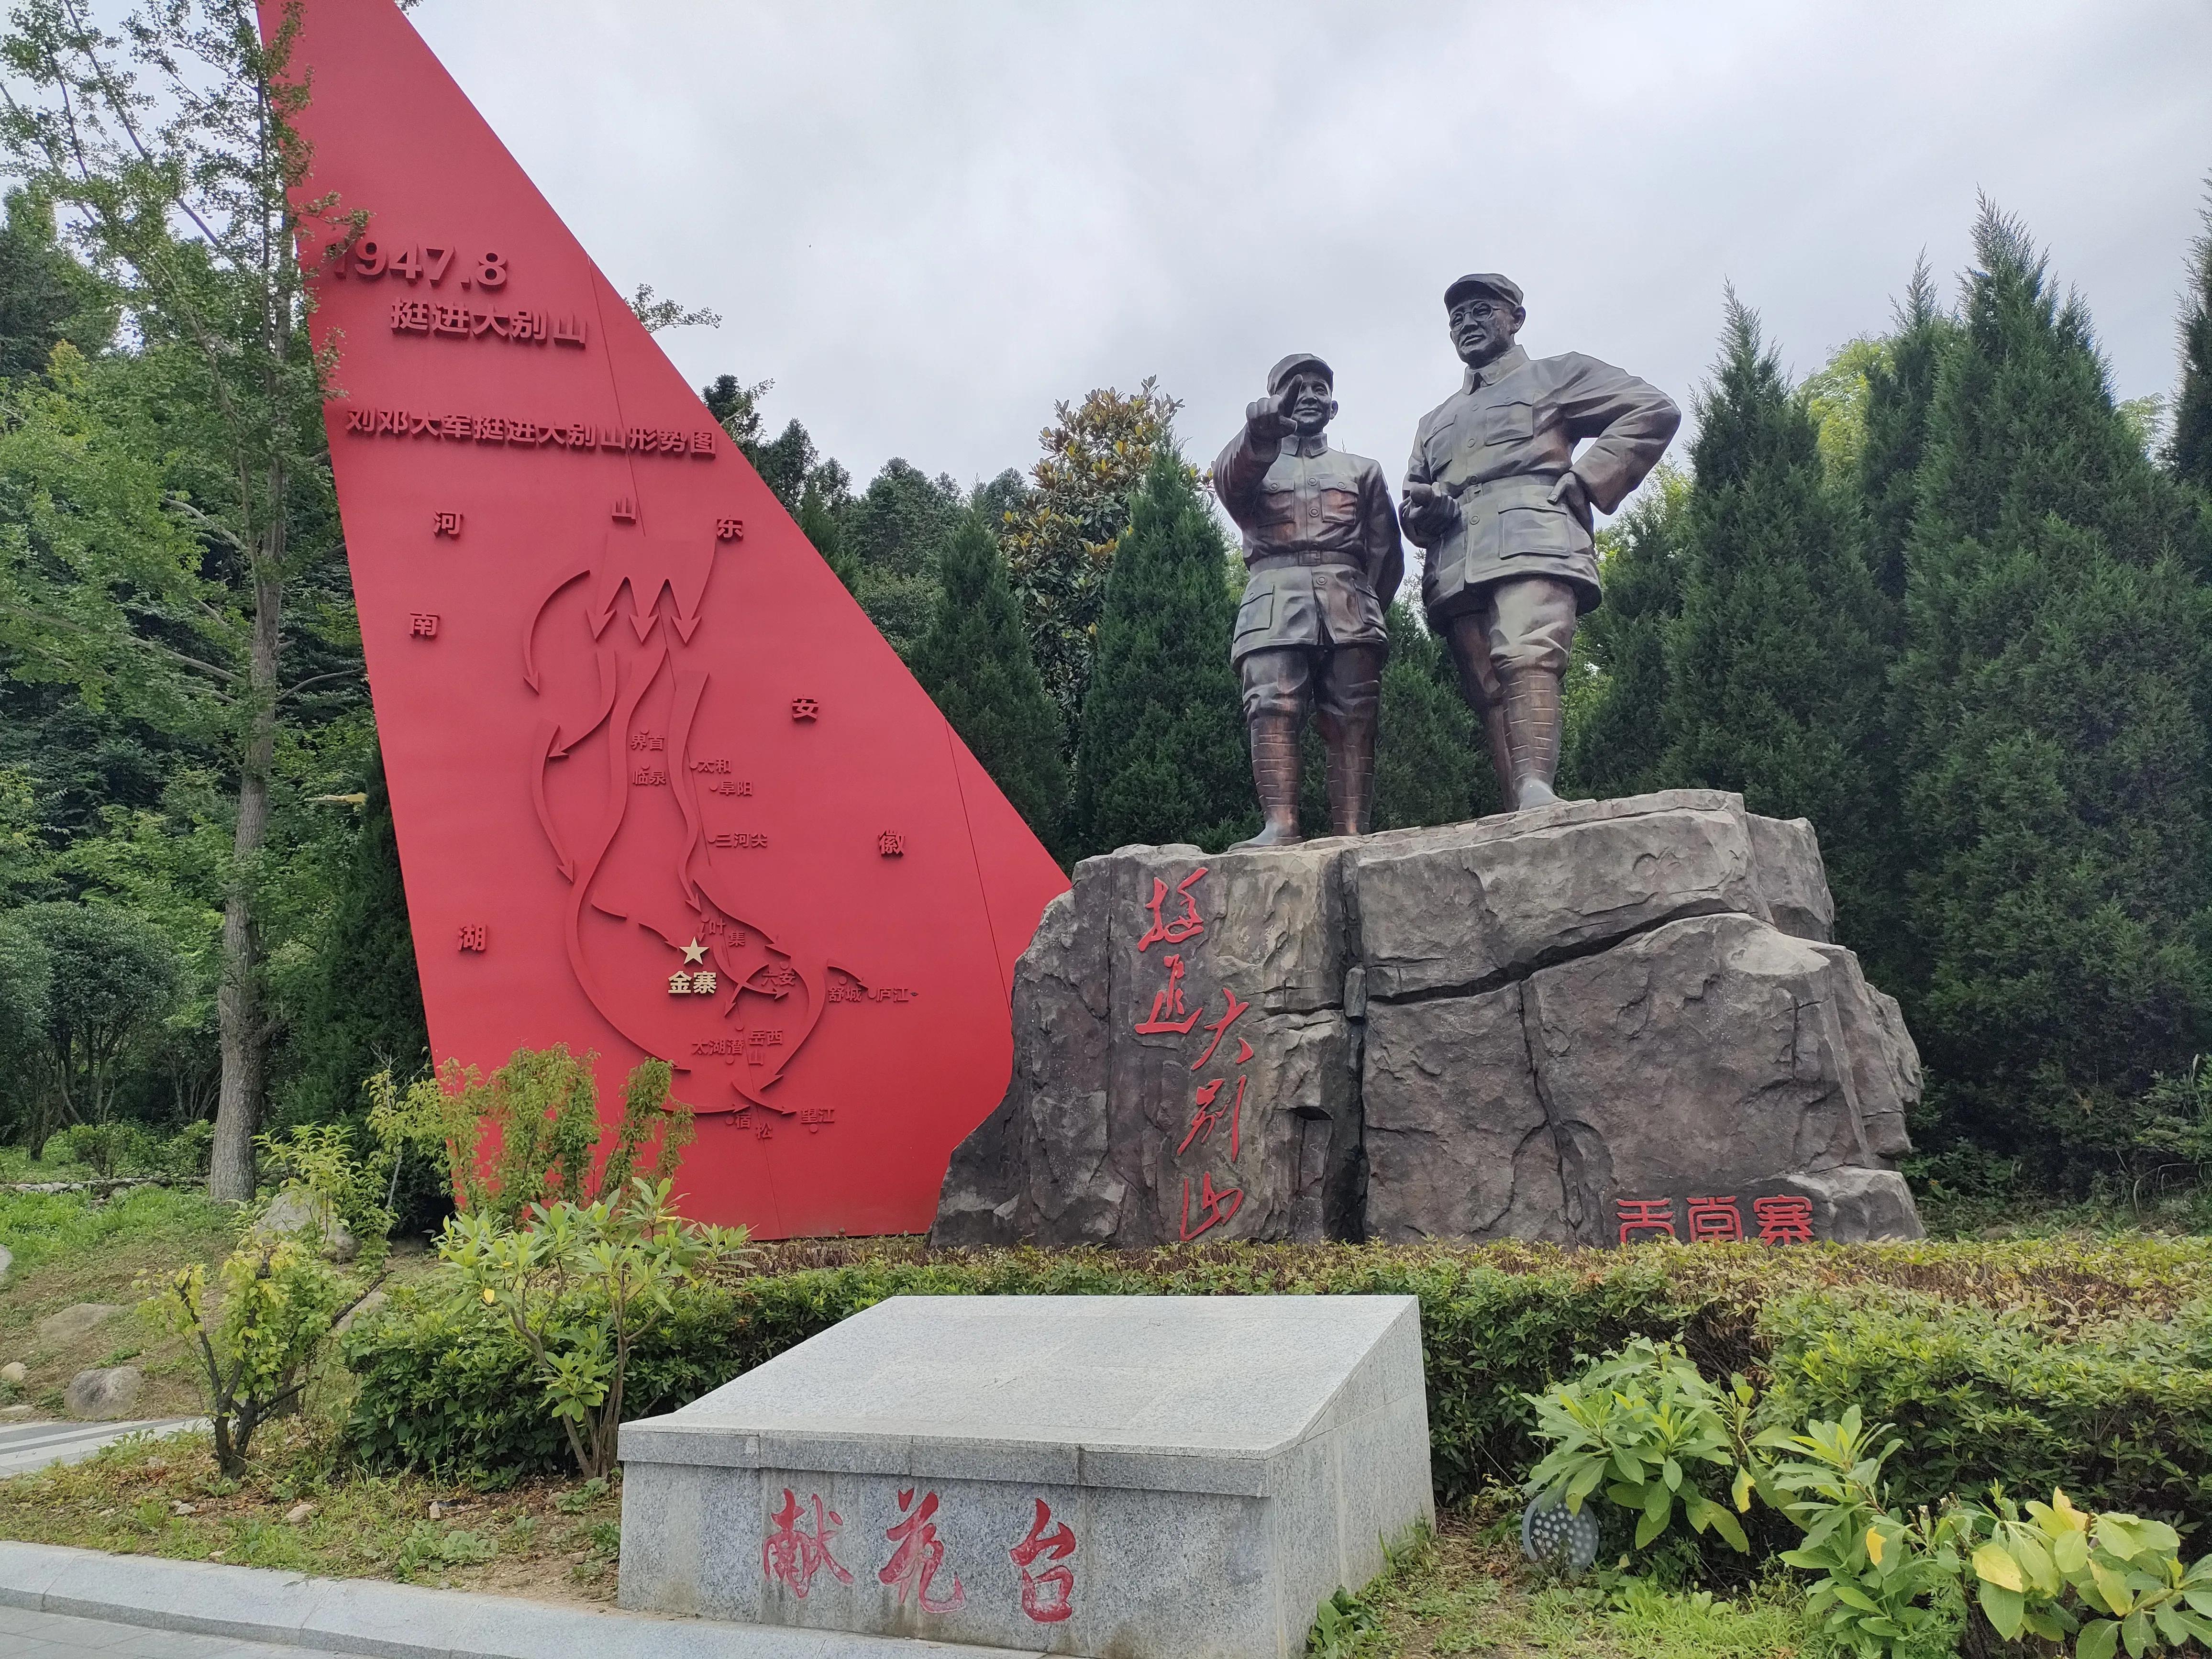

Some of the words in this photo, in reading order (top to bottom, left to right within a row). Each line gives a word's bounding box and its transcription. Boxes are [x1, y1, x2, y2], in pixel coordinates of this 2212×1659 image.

[390, 297, 587, 349] 挺进大别山
[345, 409, 717, 458] 刘邓大军挺进大别山形势图
[630, 734, 665, 751] 界首
[697, 759, 731, 774] 太和
[632, 770, 666, 786] 临泉
[719, 781, 753, 796] 阜阳
[716, 832, 768, 848] 三河尖
[457, 924, 487, 953] 湖
[668, 970, 717, 995] 金寨
[762, 971, 796, 986] 六安
[828, 985, 862, 1003] 舒城
[876, 987, 909, 1003] 庐江
[748, 1029, 783, 1046] 岳西
[801, 1107, 835, 1125] 望江
[1616, 1194, 1815, 1246] 天堂寨
[763, 1487, 1076, 1624] 献花台
